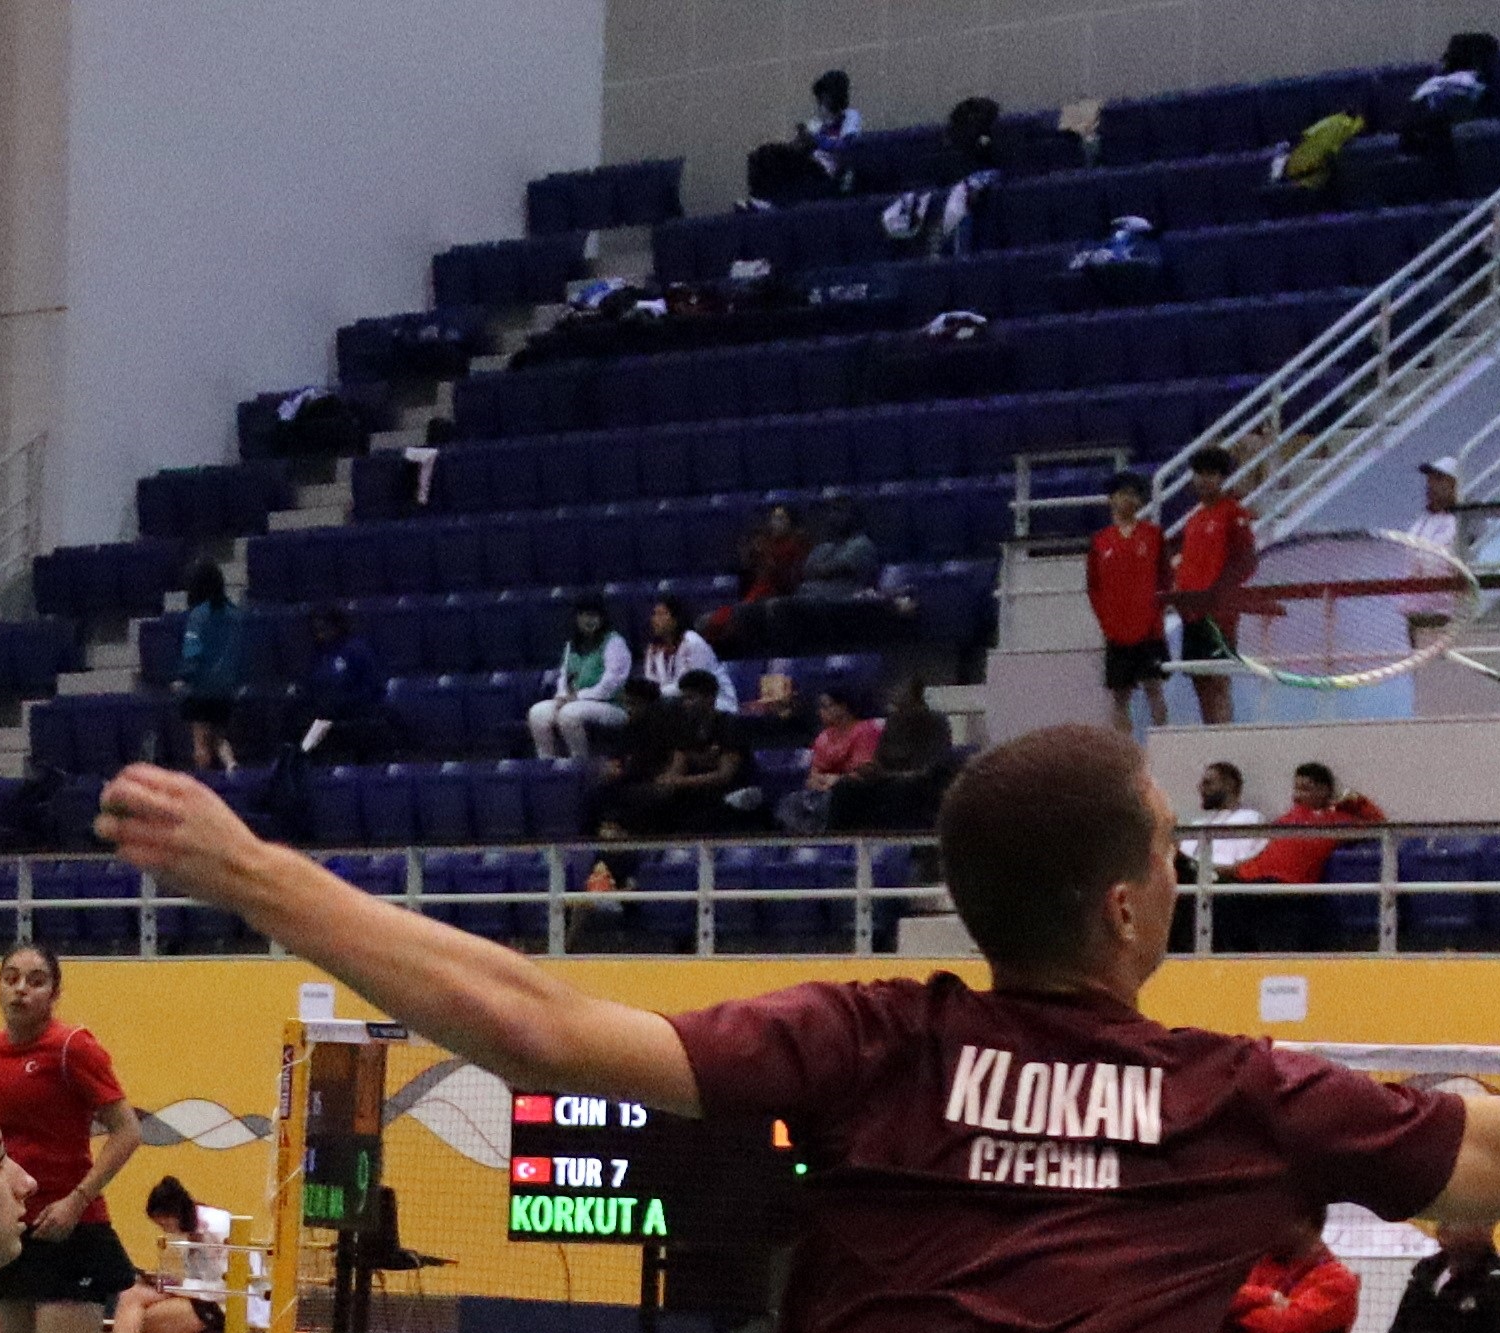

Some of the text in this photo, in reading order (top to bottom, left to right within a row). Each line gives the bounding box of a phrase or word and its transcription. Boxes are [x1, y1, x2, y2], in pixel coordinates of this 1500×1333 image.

[554, 1096, 648, 1128] CHN 15
[945, 1045, 1164, 1145] KLOKAN
[552, 1157, 629, 1188] TUR 7
[510, 1195, 668, 1236] KORKUT A
